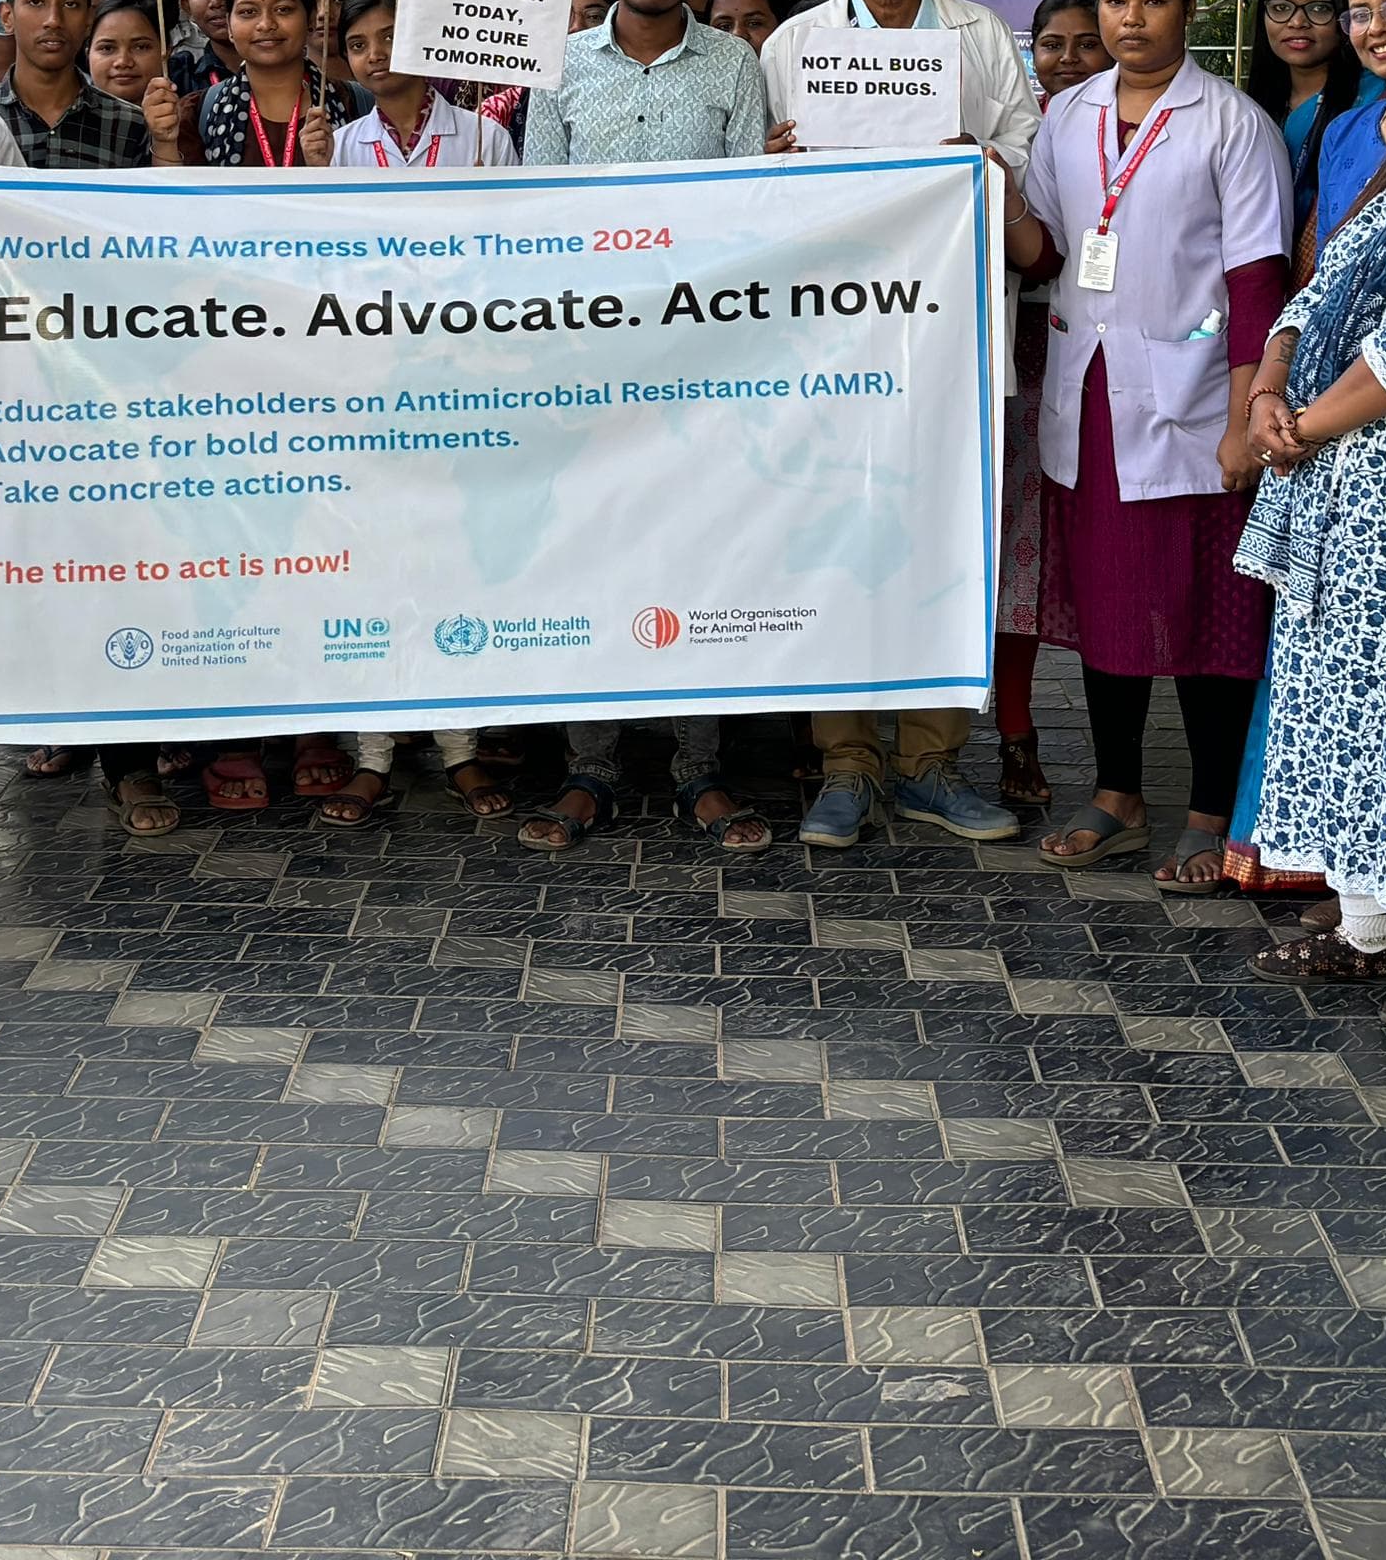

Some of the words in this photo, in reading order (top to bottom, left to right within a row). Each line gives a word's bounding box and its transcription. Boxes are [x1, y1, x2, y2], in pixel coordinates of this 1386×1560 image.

[453, 3, 522, 25] TODAY,
[442, 26, 469, 39] NO
[476, 29, 528, 47] CURE
[423, 47, 541, 72] TOMORROW.
[802, 57, 841, 69] NOT
[848, 58, 883, 70] ALL
[890, 58, 942, 72] BUGS
[808, 81, 858, 94] NEED
[865, 82, 936, 95] DRUGS.
[101, 237, 178, 258] AMR
[188, 236, 367, 257] Awareness
[377, 235, 465, 256] Week
[474, 234, 583, 255] Theme
[594, 228, 673, 251] 2024
[305, 288, 641, 337] Advocate.
[660, 280, 771, 325] Act
[790, 279, 940, 317] now.
[127, 392, 336, 418] stakeholders
[346, 397, 384, 413] on
[395, 383, 612, 411] Antimicrobial
[622, 378, 789, 402] Resistance
[799, 370, 905, 399] (AMR).
[149, 435, 196, 457] for
[207, 431, 277, 456] bold
[287, 426, 520, 454] commitments.
[69, 477, 214, 502] concrete
[225, 471, 350, 496] actions.
[53, 560, 126, 582] time
[135, 561, 169, 580] to
[180, 557, 230, 579] act
[240, 553, 263, 576] is
[275, 550, 349, 575] now!
[688, 608, 728, 621] World
[731, 606, 817, 622] Organisation
[161, 630, 190, 640] Food
[193, 628, 215, 638] and
[217, 626, 281, 640] Agriculture
[323, 618, 362, 638] UN
[492, 618, 537, 633] World
[541, 616, 591, 631] Health
[689, 621, 708, 635] for
[711, 620, 757, 634] Animal
[759, 618, 804, 633] Health
[161, 641, 236, 655] Organization
[237, 640, 251, 650] of
[253, 640, 273, 650] the
[323, 640, 391, 651] environment
[492, 633, 591, 652] Organization
[161, 656, 201, 666] United
[203, 654, 247, 664] Nations
[323, 650, 386, 662] programme
